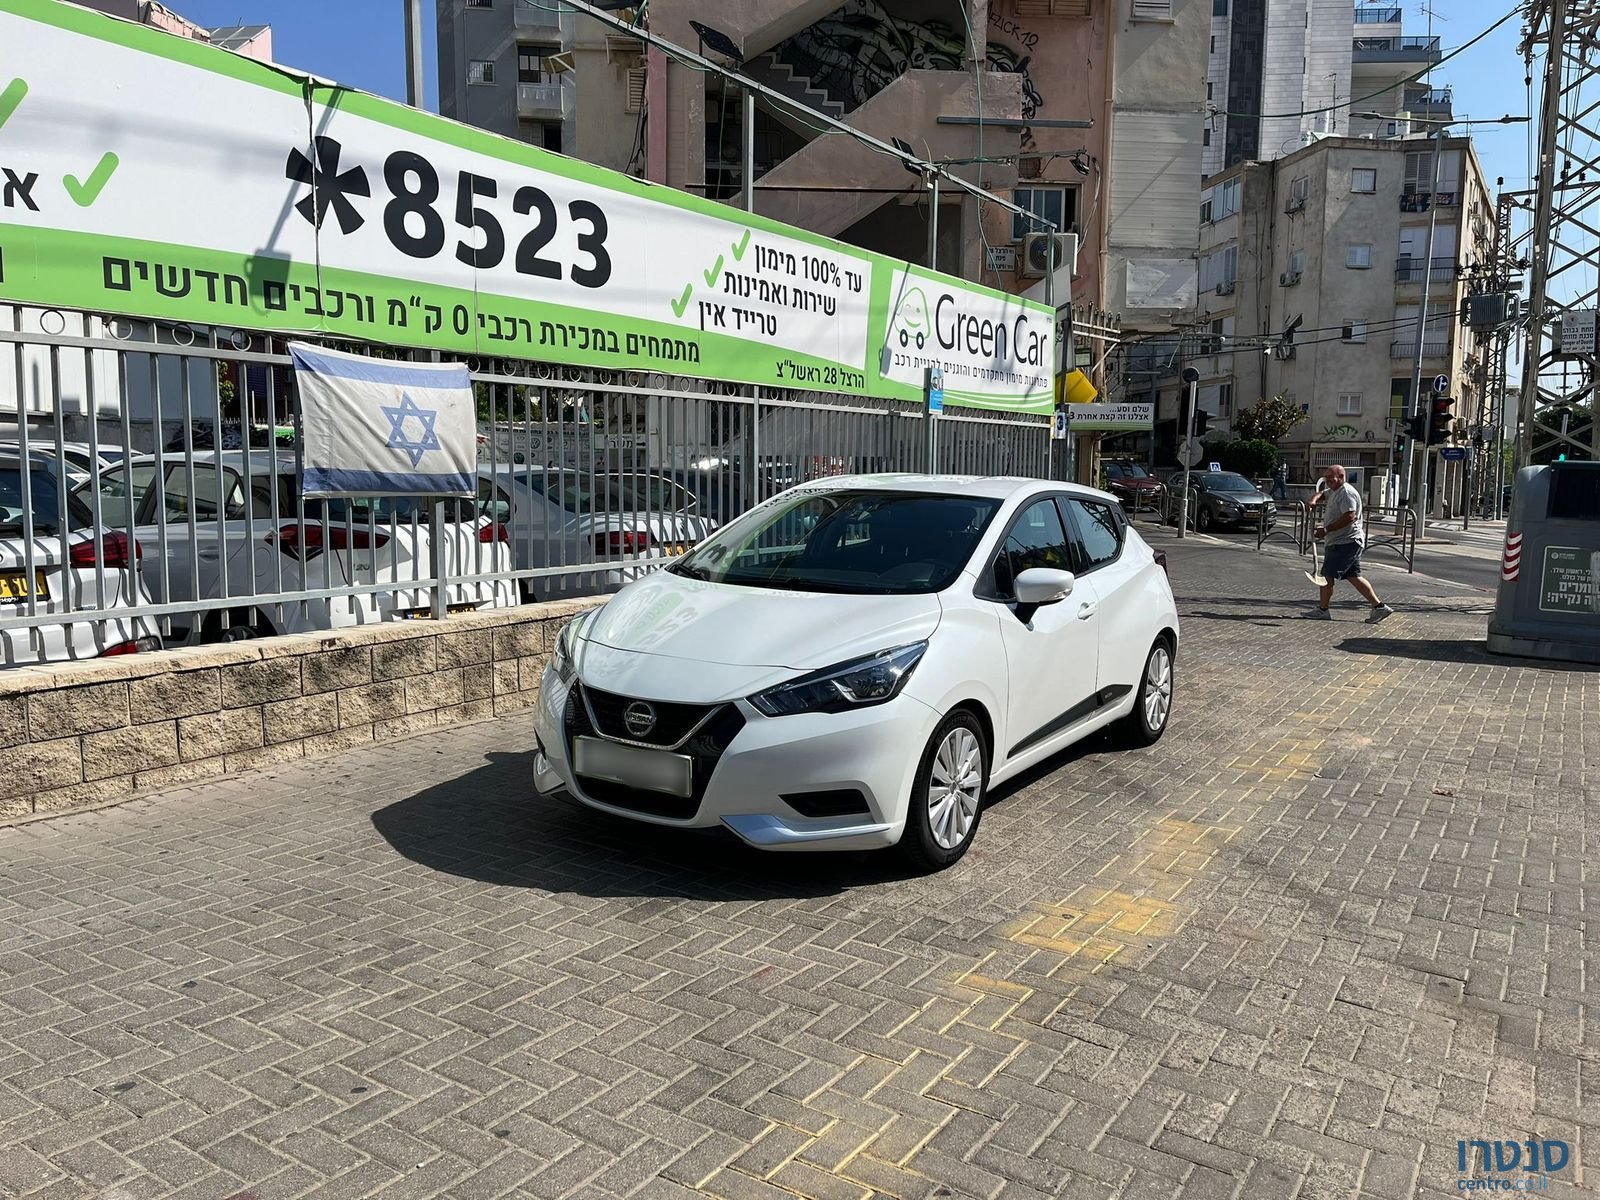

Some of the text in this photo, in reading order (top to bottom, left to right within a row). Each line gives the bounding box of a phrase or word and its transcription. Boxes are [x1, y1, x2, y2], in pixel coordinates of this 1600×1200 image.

[1021, 31, 1039, 52] 12
[754, 244, 862, 293] עד 100% מימון
[102, 256, 249, 307] חדשים
[262, 279, 375, 324] ורכבים
[724, 271, 836, 316] שירות ואמינות
[452, 304, 469, 336] 0
[477, 313, 532, 343] רכבי
[698, 300, 777, 336] טרייד אין
[539, 321, 620, 353] במכירת
[935, 293, 1048, 367] Green Car
[625, 333, 700, 363] מתמחים
[894, 353, 911, 367] רכב
[943, 361, 971, 377] והוגנים
[823, 366, 837, 385] 28
[839, 367, 865, 389] הרצל
[972, 366, 1004, 383] מתקדמים
[1006, 371, 1023, 385] מימון
[1099, 413, 1116, 421] קצת
[1128, 412, 1149, 420] אצלנו
[1132, 405, 1149, 413] שלם
[1547, 591, 1581, 606] נקייה!
[626, 711, 653, 724] NISSAN
